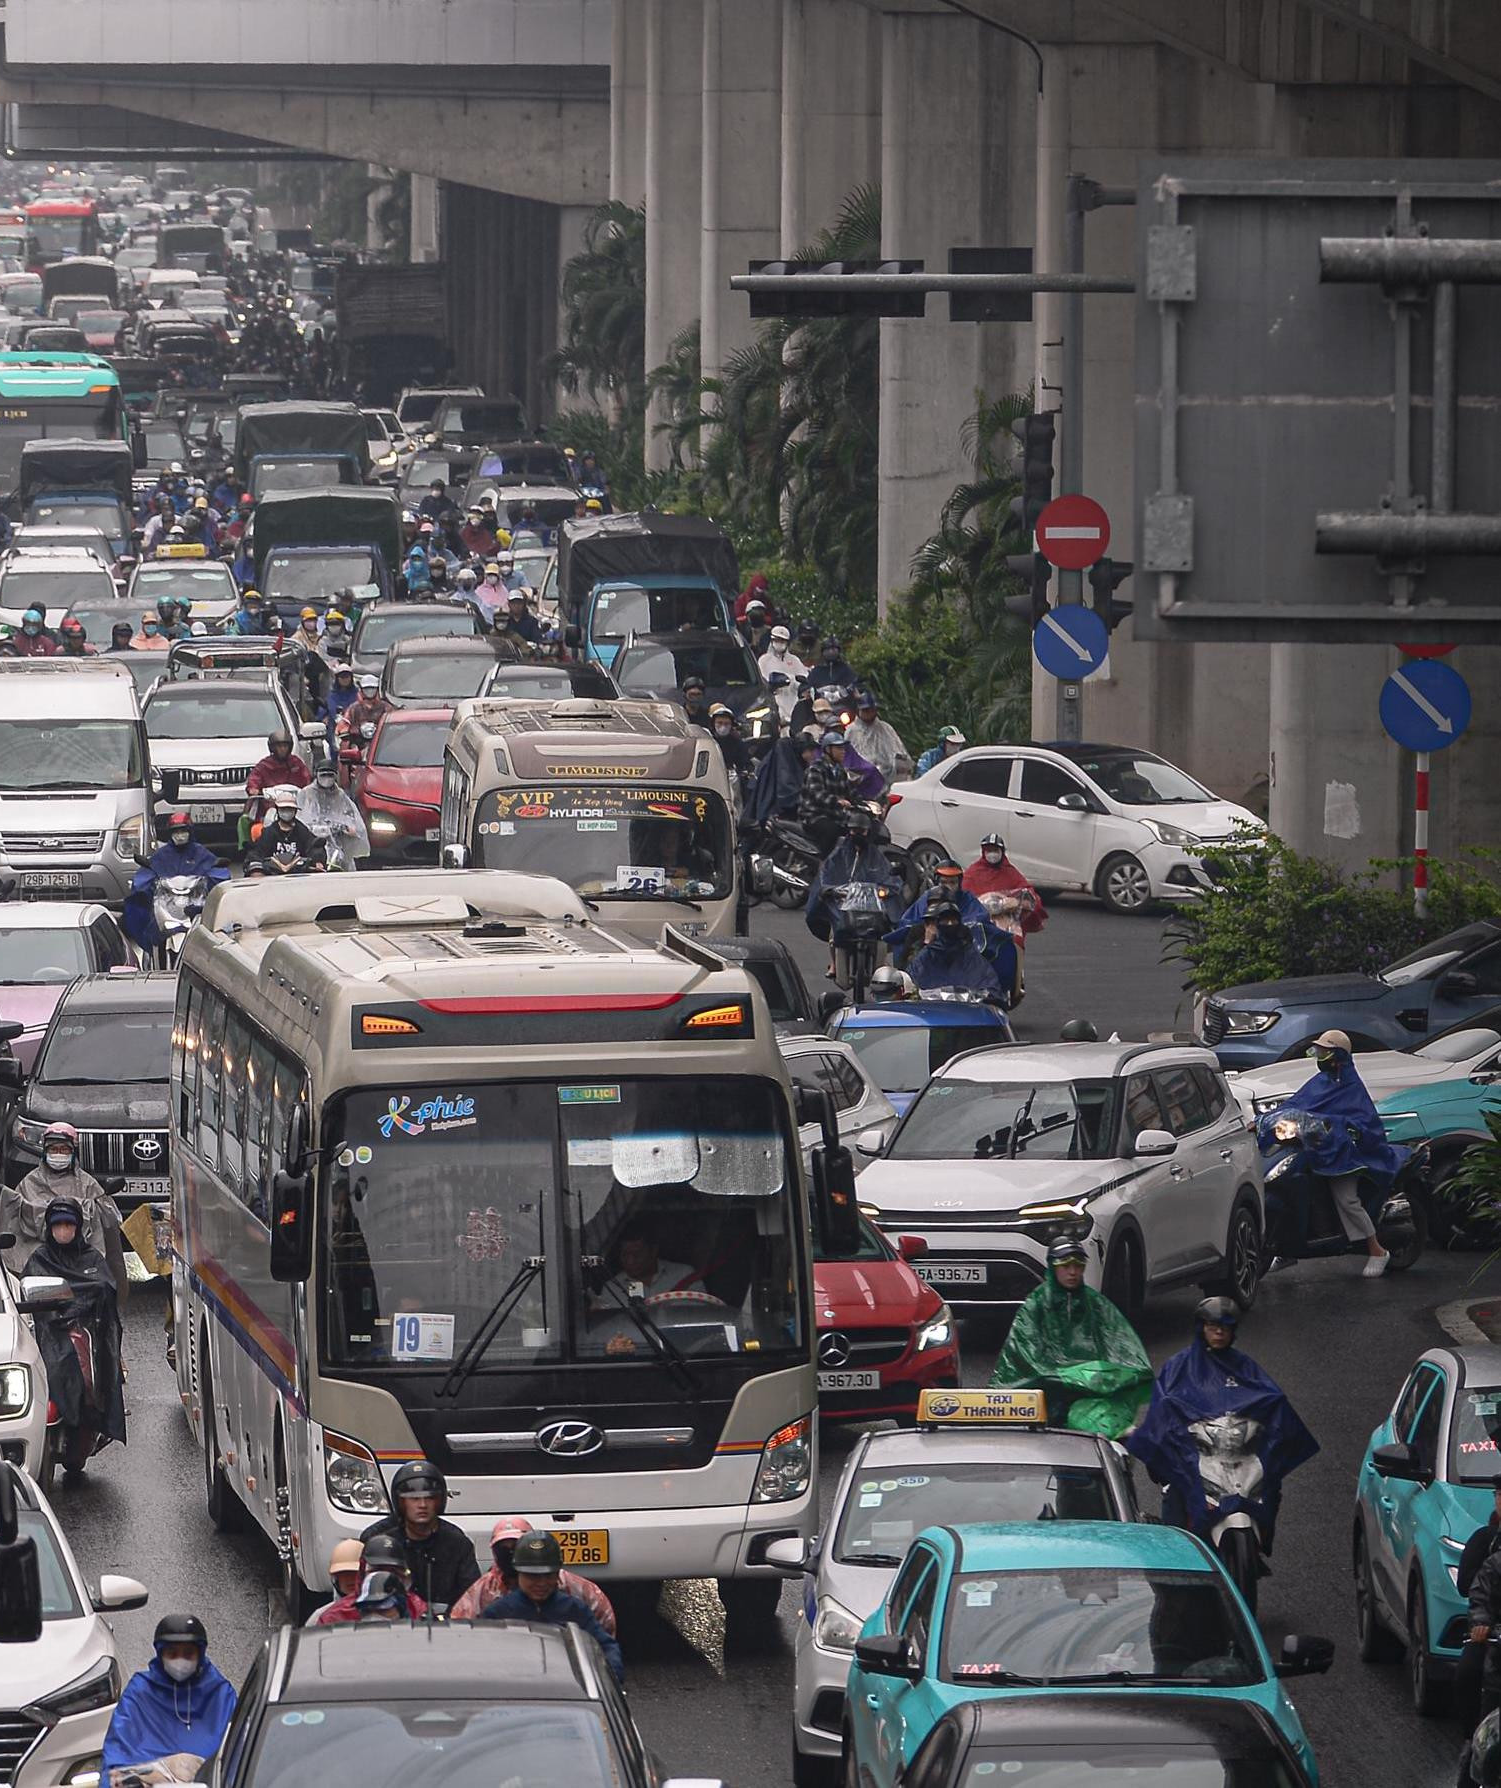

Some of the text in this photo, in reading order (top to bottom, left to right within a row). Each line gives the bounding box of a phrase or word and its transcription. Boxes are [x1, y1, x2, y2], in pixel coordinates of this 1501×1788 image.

[554, 767, 643, 777] LIMOUSINE
[520, 791, 689, 805] VIP LIMOUSINE
[550, 808, 604, 818] HYUNDAI
[628, 877, 658, 895] 26
[395, 1316, 420, 1353] 19
[986, 1395, 1012, 1404] TAXI
[963, 1406, 1036, 1417] THANH NGA
[1460, 1440, 1497, 1454] TAXI
[559, 1532, 589, 1547] 29B
[961, 1663, 1003, 1675] TAXI
